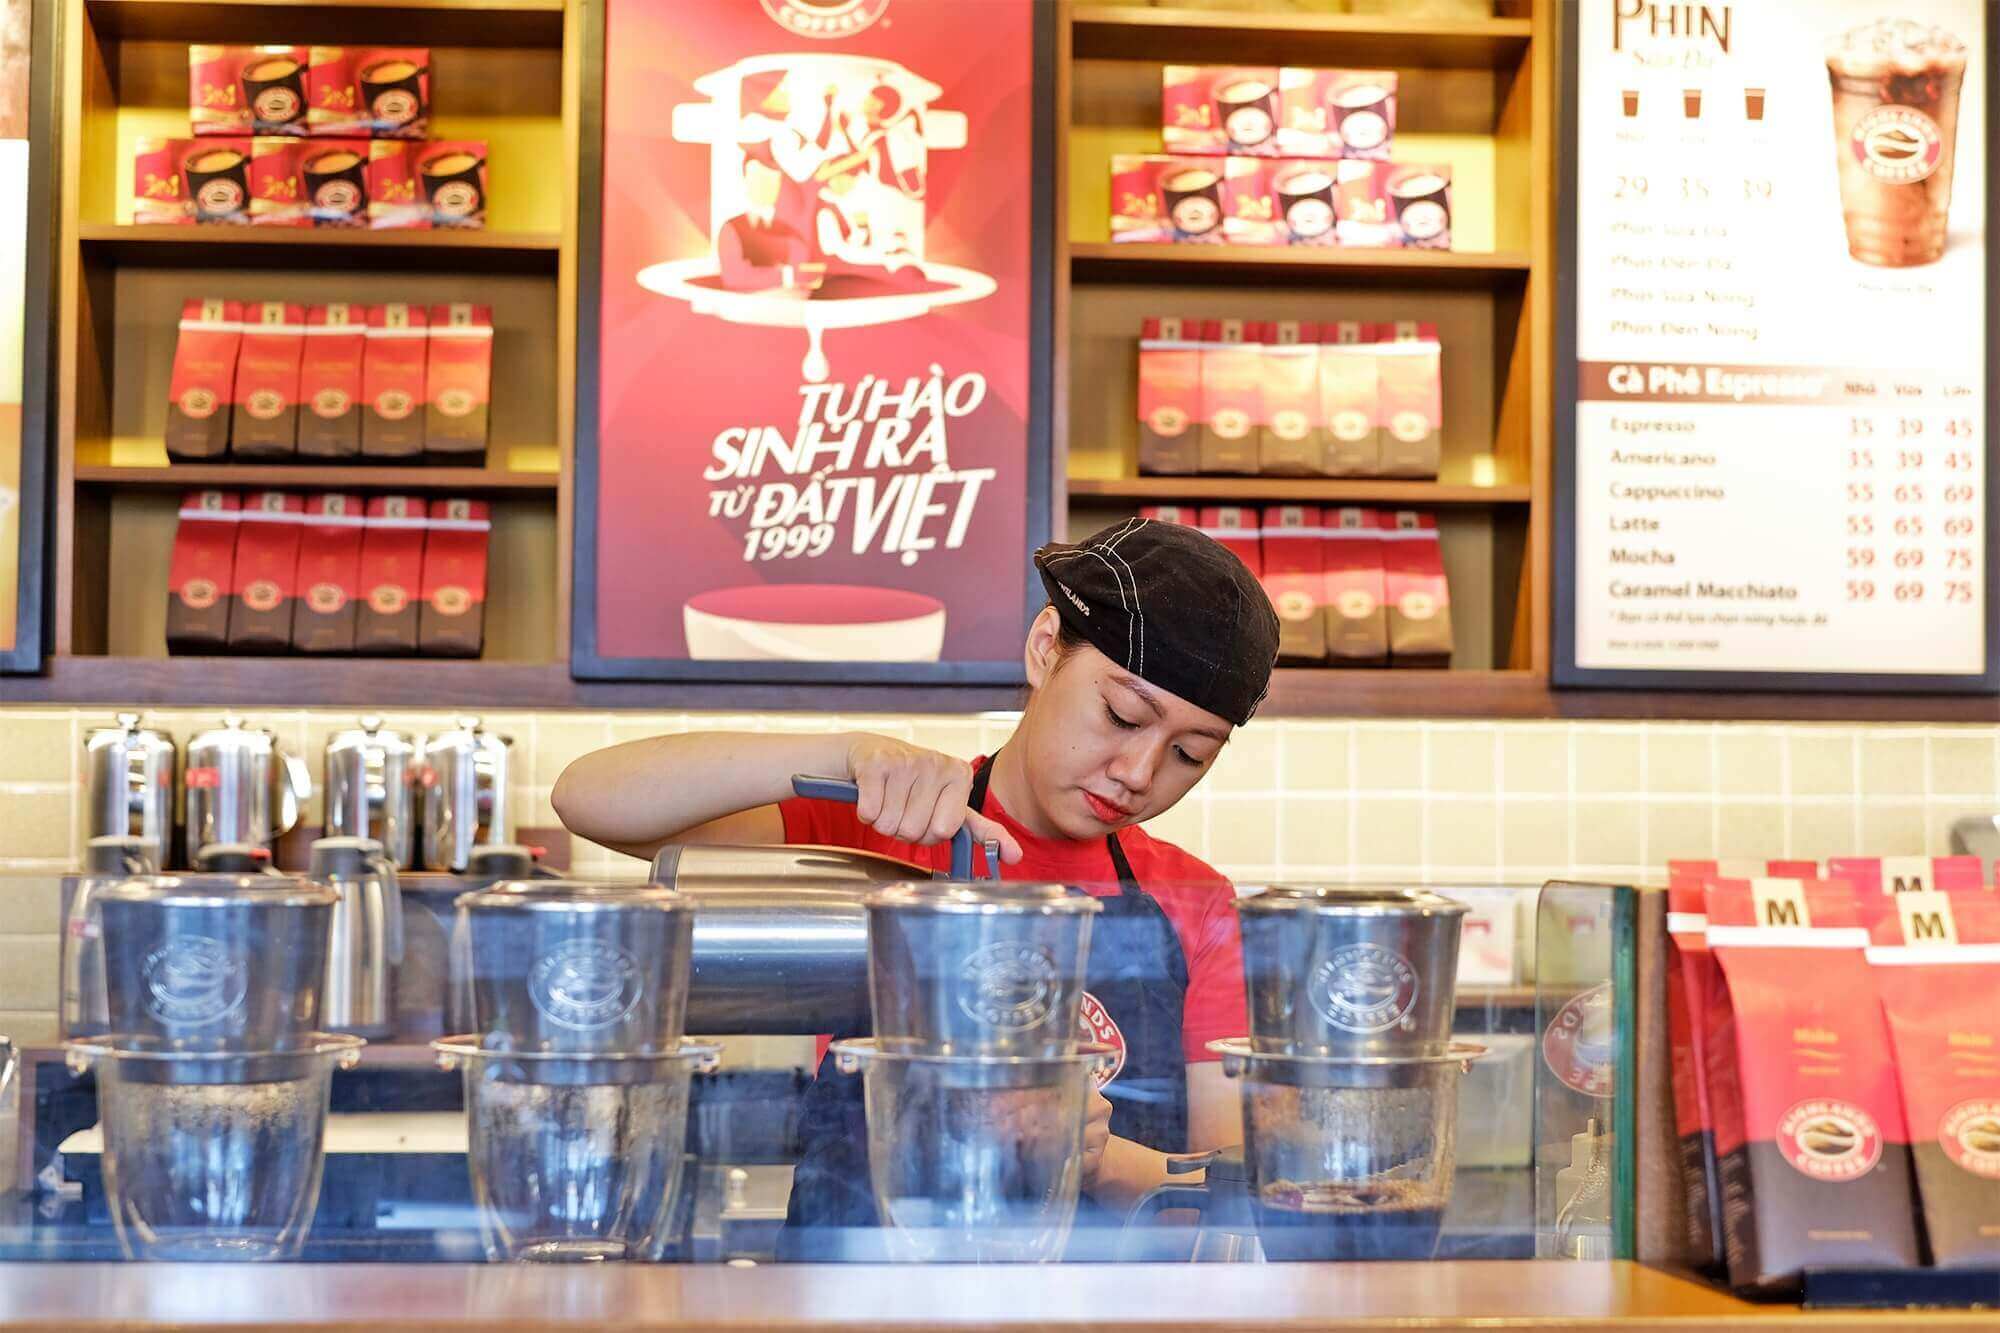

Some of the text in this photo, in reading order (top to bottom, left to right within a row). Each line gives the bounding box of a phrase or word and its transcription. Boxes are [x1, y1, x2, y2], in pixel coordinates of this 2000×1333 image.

[1611, 0, 1733, 54] PHIN
[1613, 176, 1648, 199] 29
[863, 363, 986, 423] HÀO
[1609, 417, 1696, 436] Espresso
[1944, 417, 1974, 438] 45
[703, 420, 863, 481] SINH
[1609, 449, 1717, 467] Americano
[1944, 450, 1974, 470] 45
[1608, 482, 1974, 504] Cappuccino 55 65 69
[851, 464, 997, 566] VIỆT
[1609, 515, 1974, 536] Latte 55 65 69
[743, 523, 835, 561] 1999
[1609, 548, 1974, 569] Mocha 59 69 75
[1608, 581, 1974, 603] Caramel Macchiato 59 69 75
[1766, 899, 1799, 926] M
[1911, 911, 1946, 939] M
